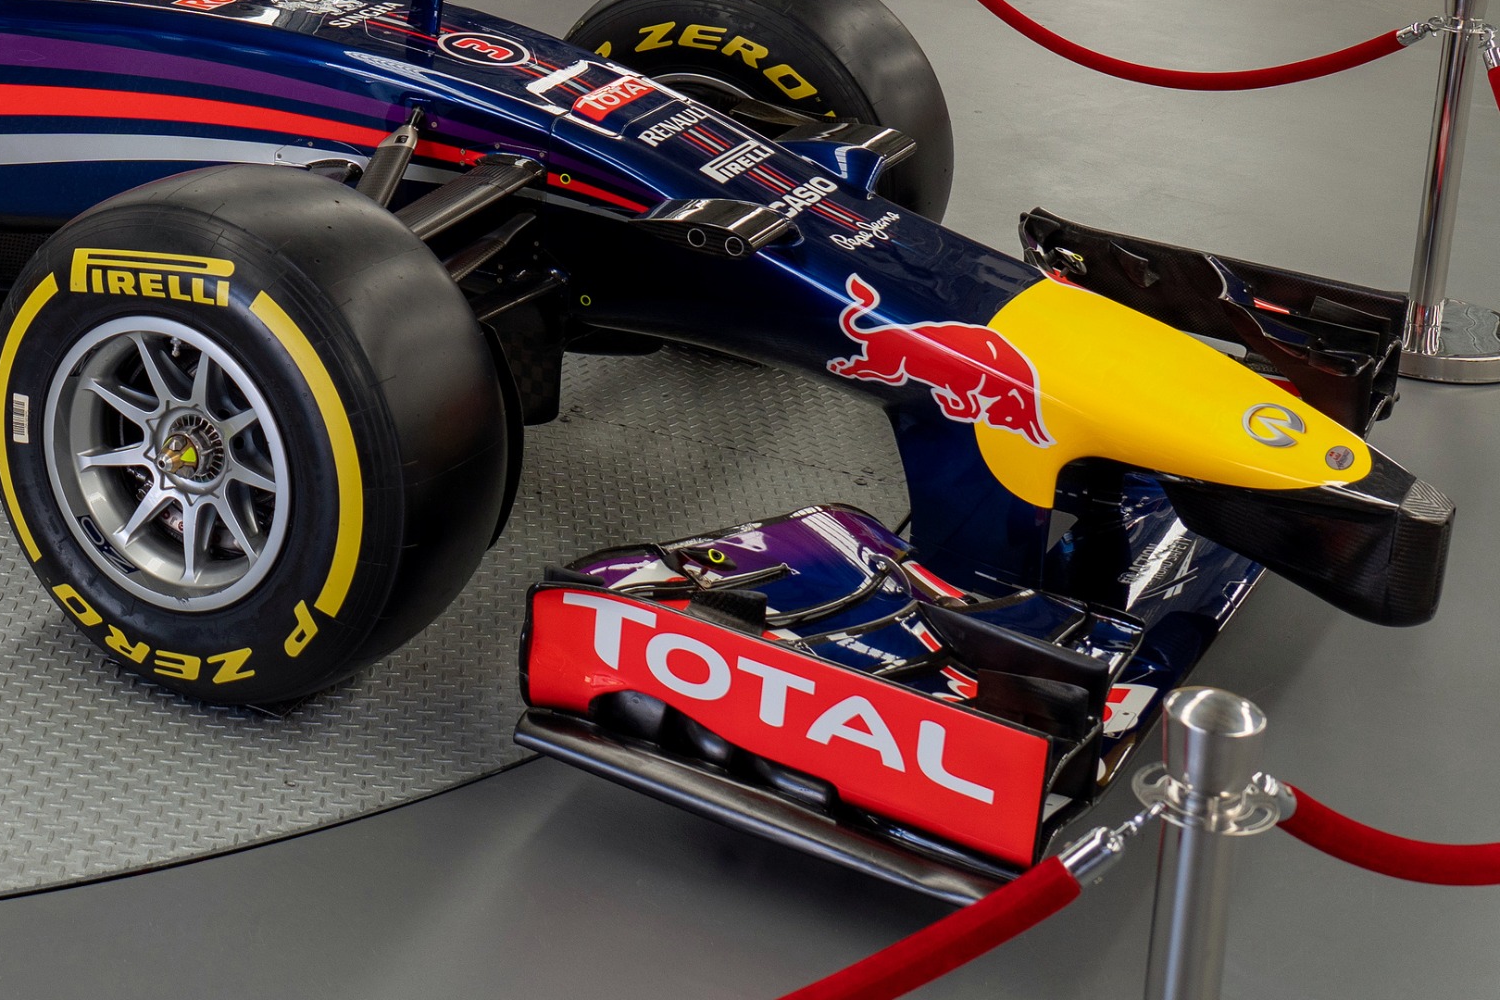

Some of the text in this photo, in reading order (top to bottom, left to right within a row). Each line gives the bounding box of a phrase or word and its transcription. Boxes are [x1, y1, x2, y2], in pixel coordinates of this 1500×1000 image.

[328, 1, 405, 29] SINGHA
[633, 20, 819, 101] ZERO
[699, 139, 776, 184] PIRELLI
[767, 174, 839, 218] CASIO
[829, 210, 901, 252] Pepe Jeans
[69, 247, 236, 308] PIRELLI
[51, 582, 320, 685] P ZERO
[562, 591, 995, 805] TOTAL
